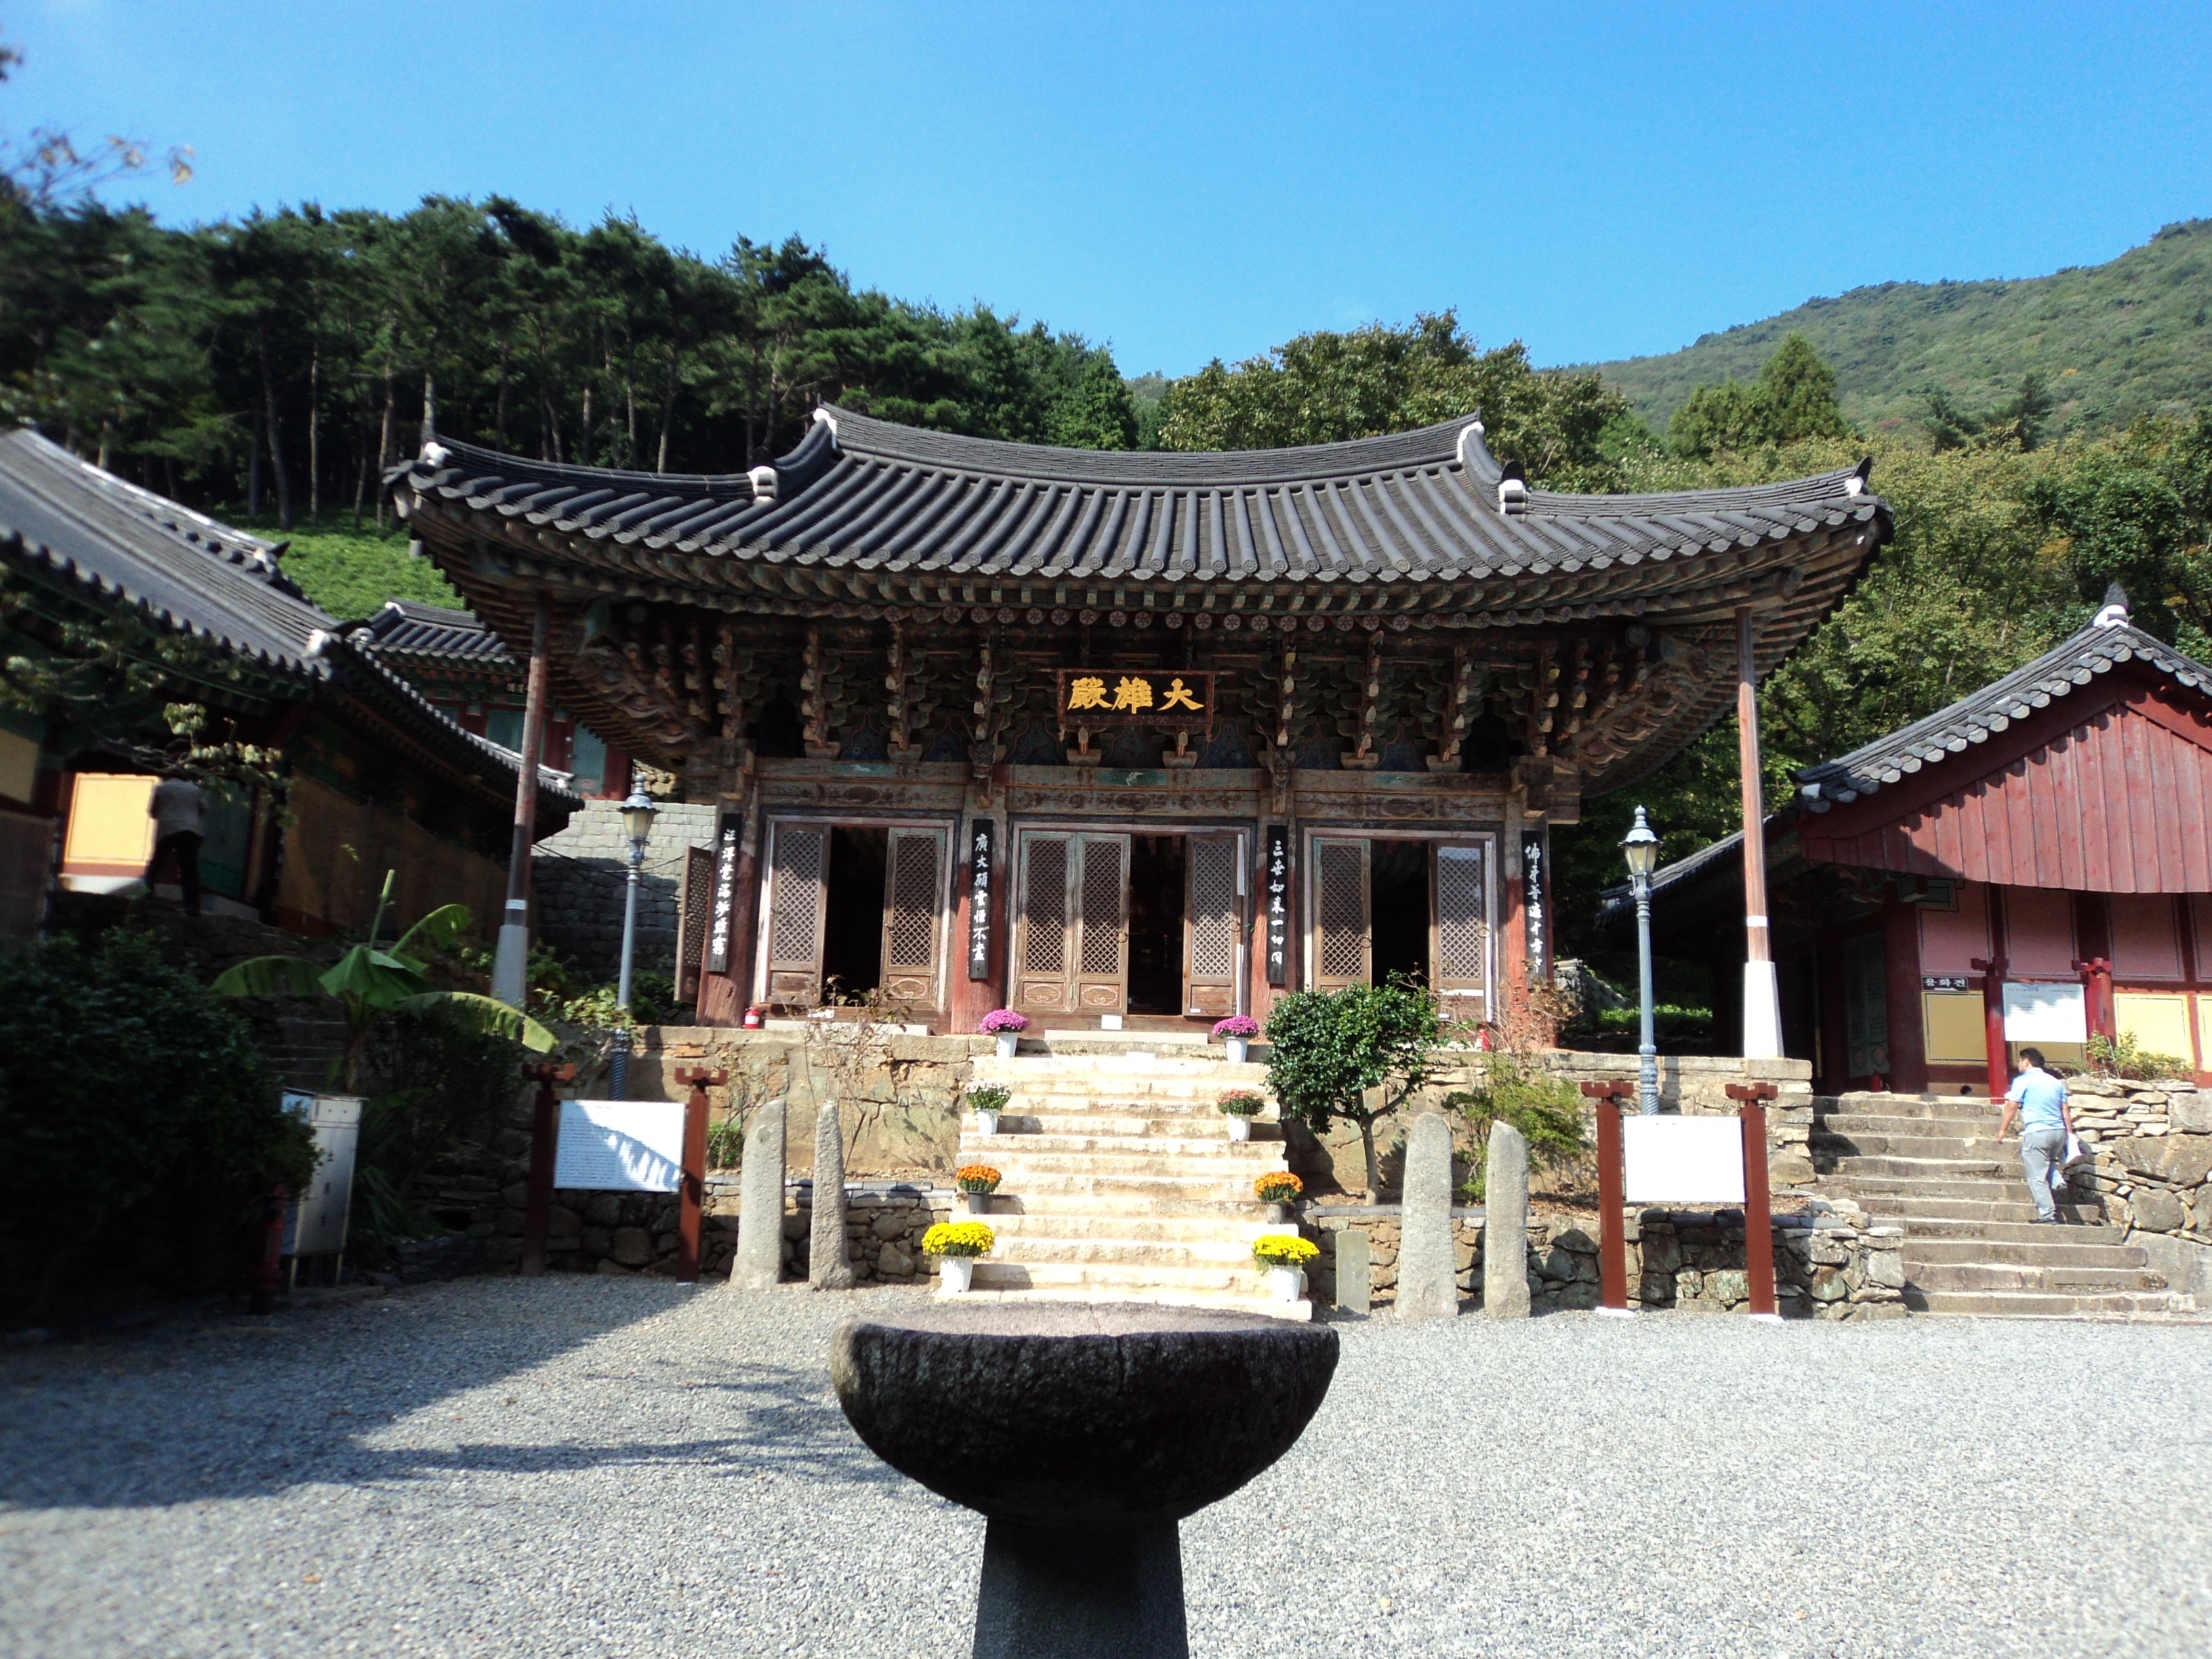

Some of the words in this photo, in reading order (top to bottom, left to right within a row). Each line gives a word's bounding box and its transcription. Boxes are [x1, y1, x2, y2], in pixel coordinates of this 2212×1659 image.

[1067, 675, 1205, 714] 大雄殿
[1924, 978, 1966, 987] 용화전
